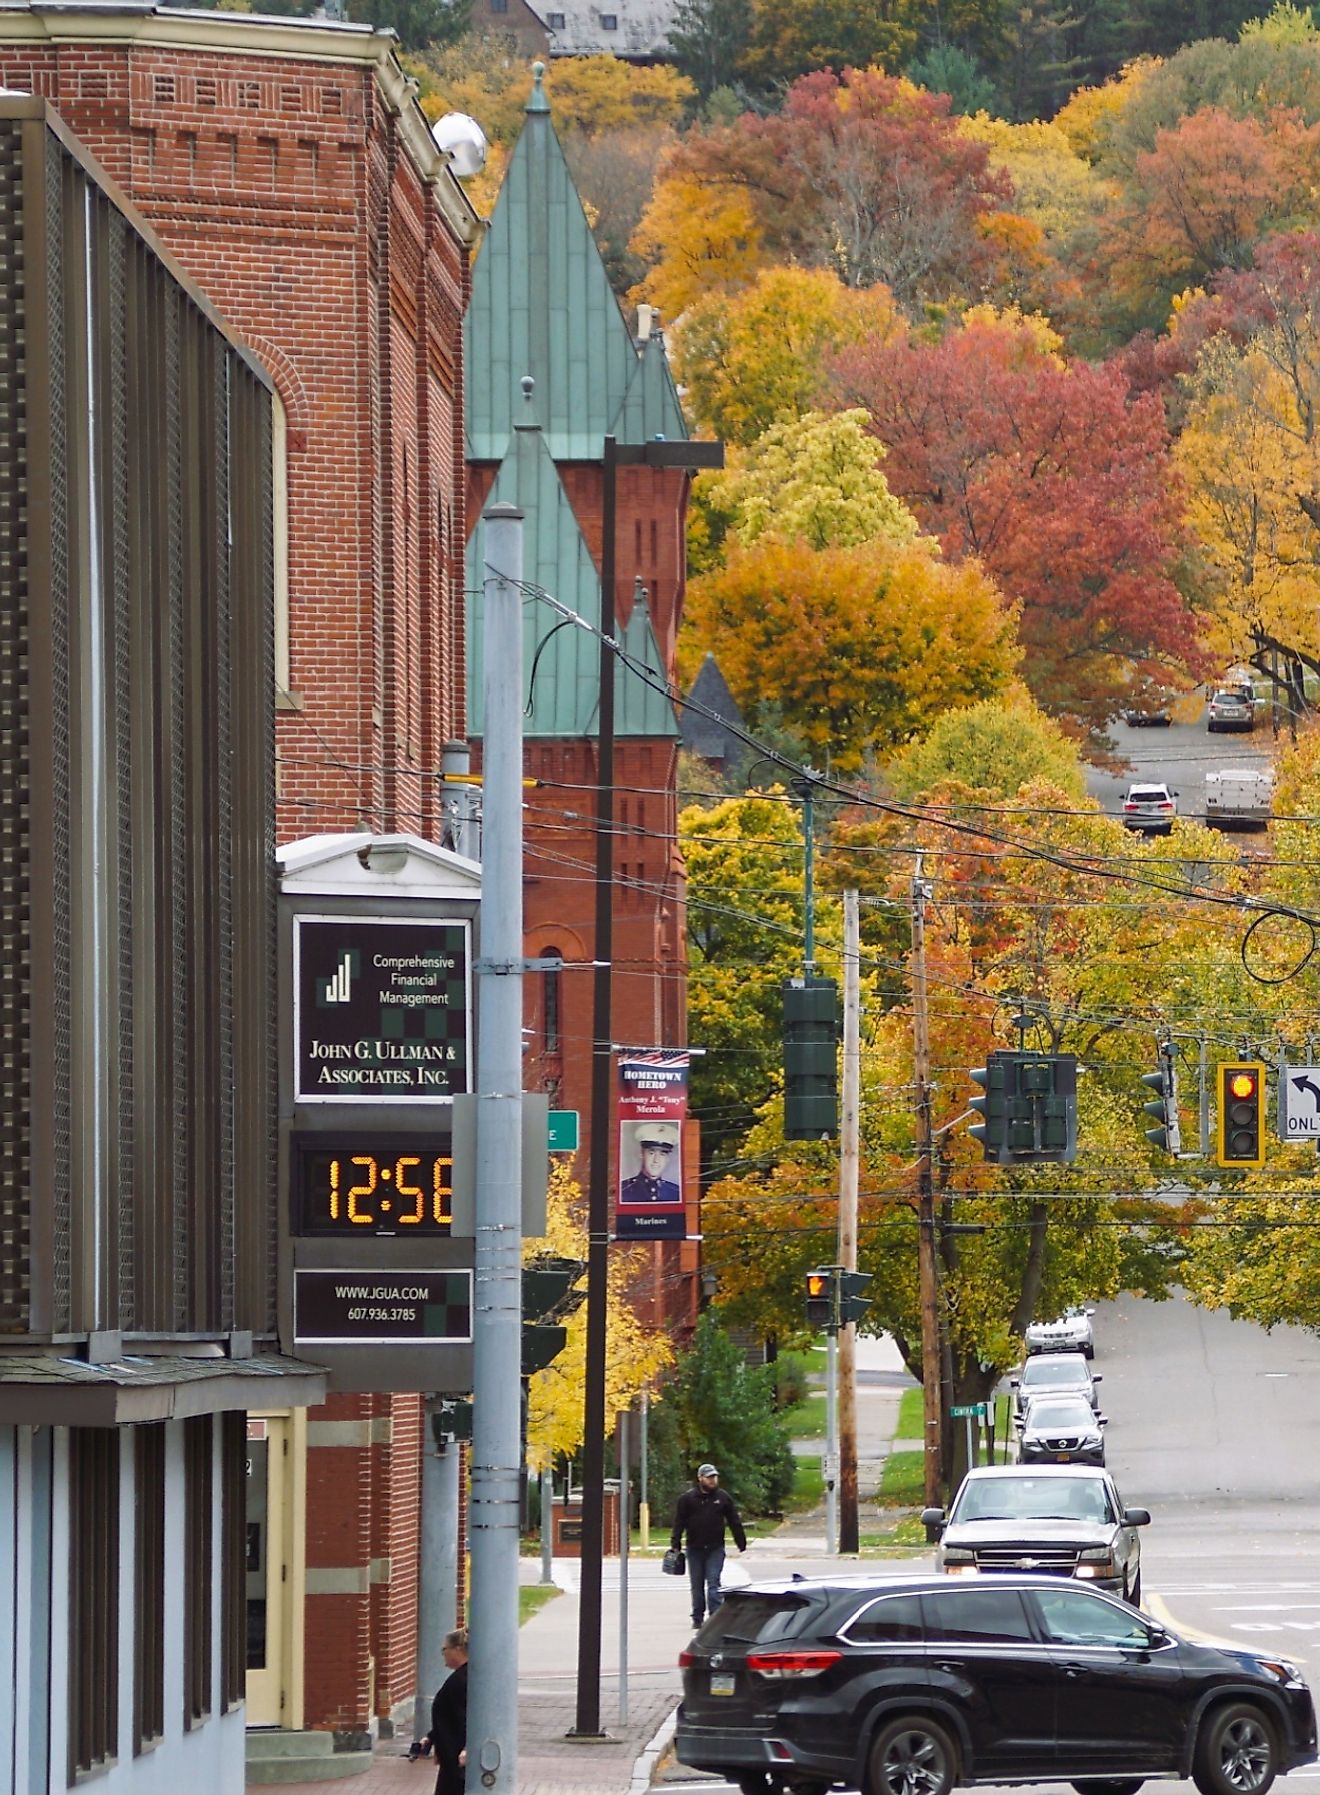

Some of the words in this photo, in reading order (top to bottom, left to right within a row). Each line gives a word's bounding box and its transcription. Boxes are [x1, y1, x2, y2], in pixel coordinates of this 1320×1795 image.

[373, 954, 455, 971] Comprehensive
[391, 973, 437, 986] Financial
[379, 990, 449, 1007] Management
[309, 1040, 351, 1059] JOHN
[354, 1040, 373, 1059] G.
[375, 1041, 443, 1060] ULLMAN
[446, 1046, 456, 1060] &
[317, 1065, 415, 1086] ASSOCIATES,
[416, 1066, 449, 1085] INC.
[624, 1071, 681, 1081] HOMETOWN
[637, 1081, 667, 1089] HERO
[619, 1096, 649, 1105] Anthony
[635, 1217, 668, 1226] Marines
[335, 1286, 429, 1300] WWW.JGUA.COM
[348, 1308, 416, 1321] 607.936.3785
